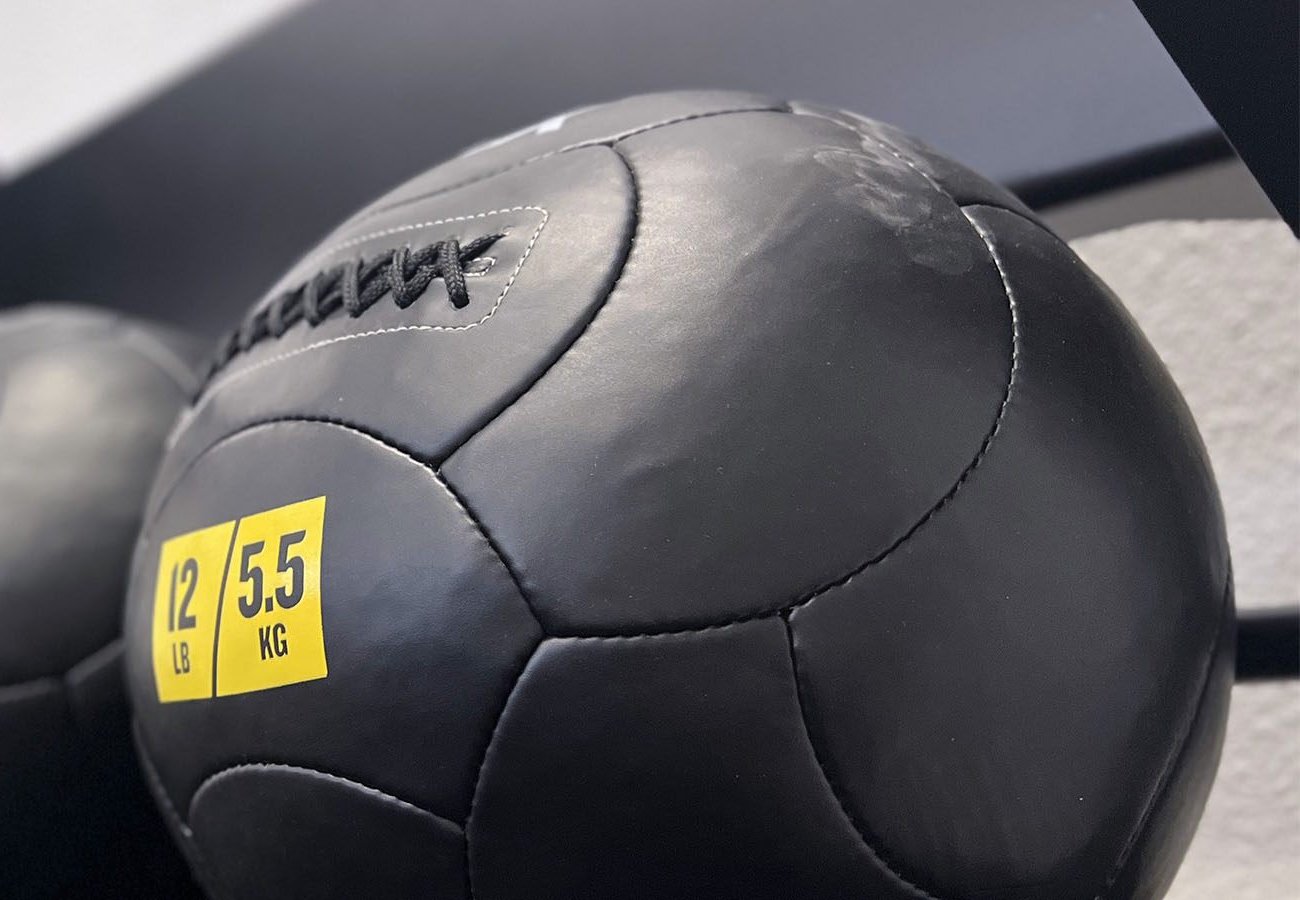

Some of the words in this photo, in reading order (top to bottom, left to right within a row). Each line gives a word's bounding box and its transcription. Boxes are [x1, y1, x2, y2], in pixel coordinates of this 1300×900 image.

[168, 558, 198, 632] 12
[238, 529, 306, 618] 5.5
[172, 642, 190, 675] LB
[259, 623, 288, 660] KG
